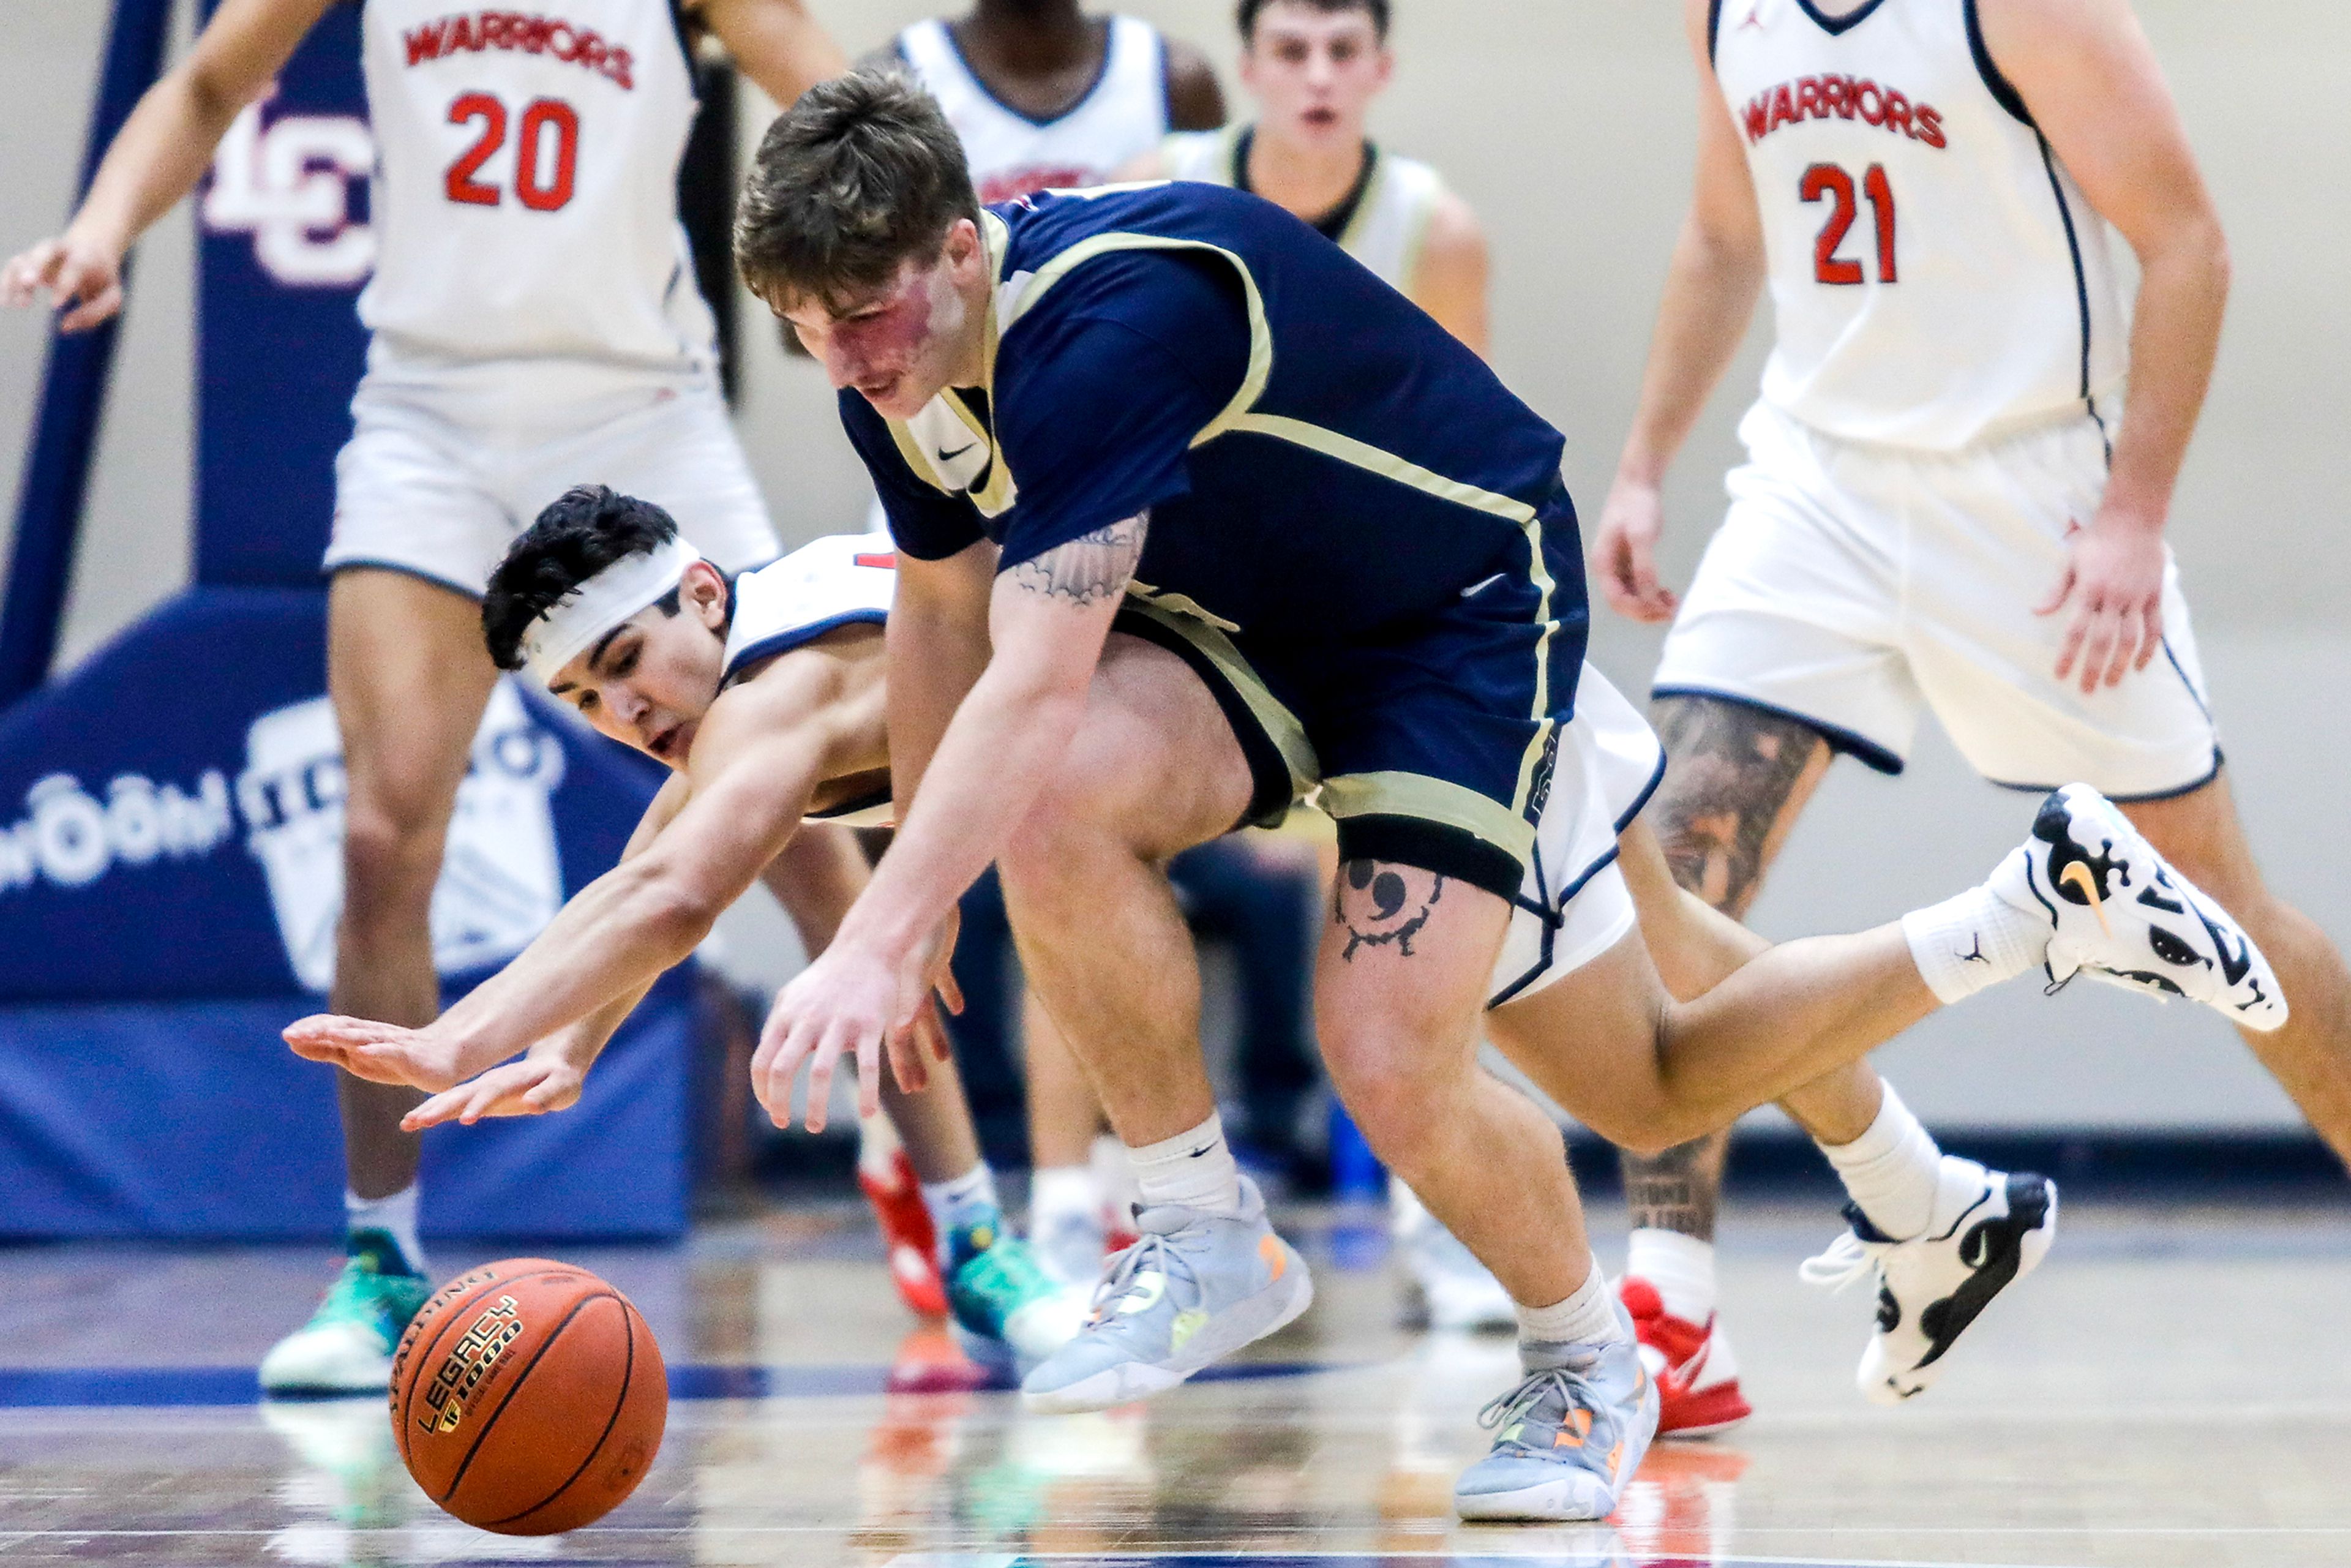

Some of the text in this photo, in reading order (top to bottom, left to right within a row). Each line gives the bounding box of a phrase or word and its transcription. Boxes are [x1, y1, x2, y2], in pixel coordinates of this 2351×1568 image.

[404, 11, 635, 91] WARRIORS
[1741, 73, 1946, 149] WARRIORS
[445, 91, 579, 212] 20
[1799, 162, 1897, 284] 21
[418, 1295, 519, 1434] LEGACY
